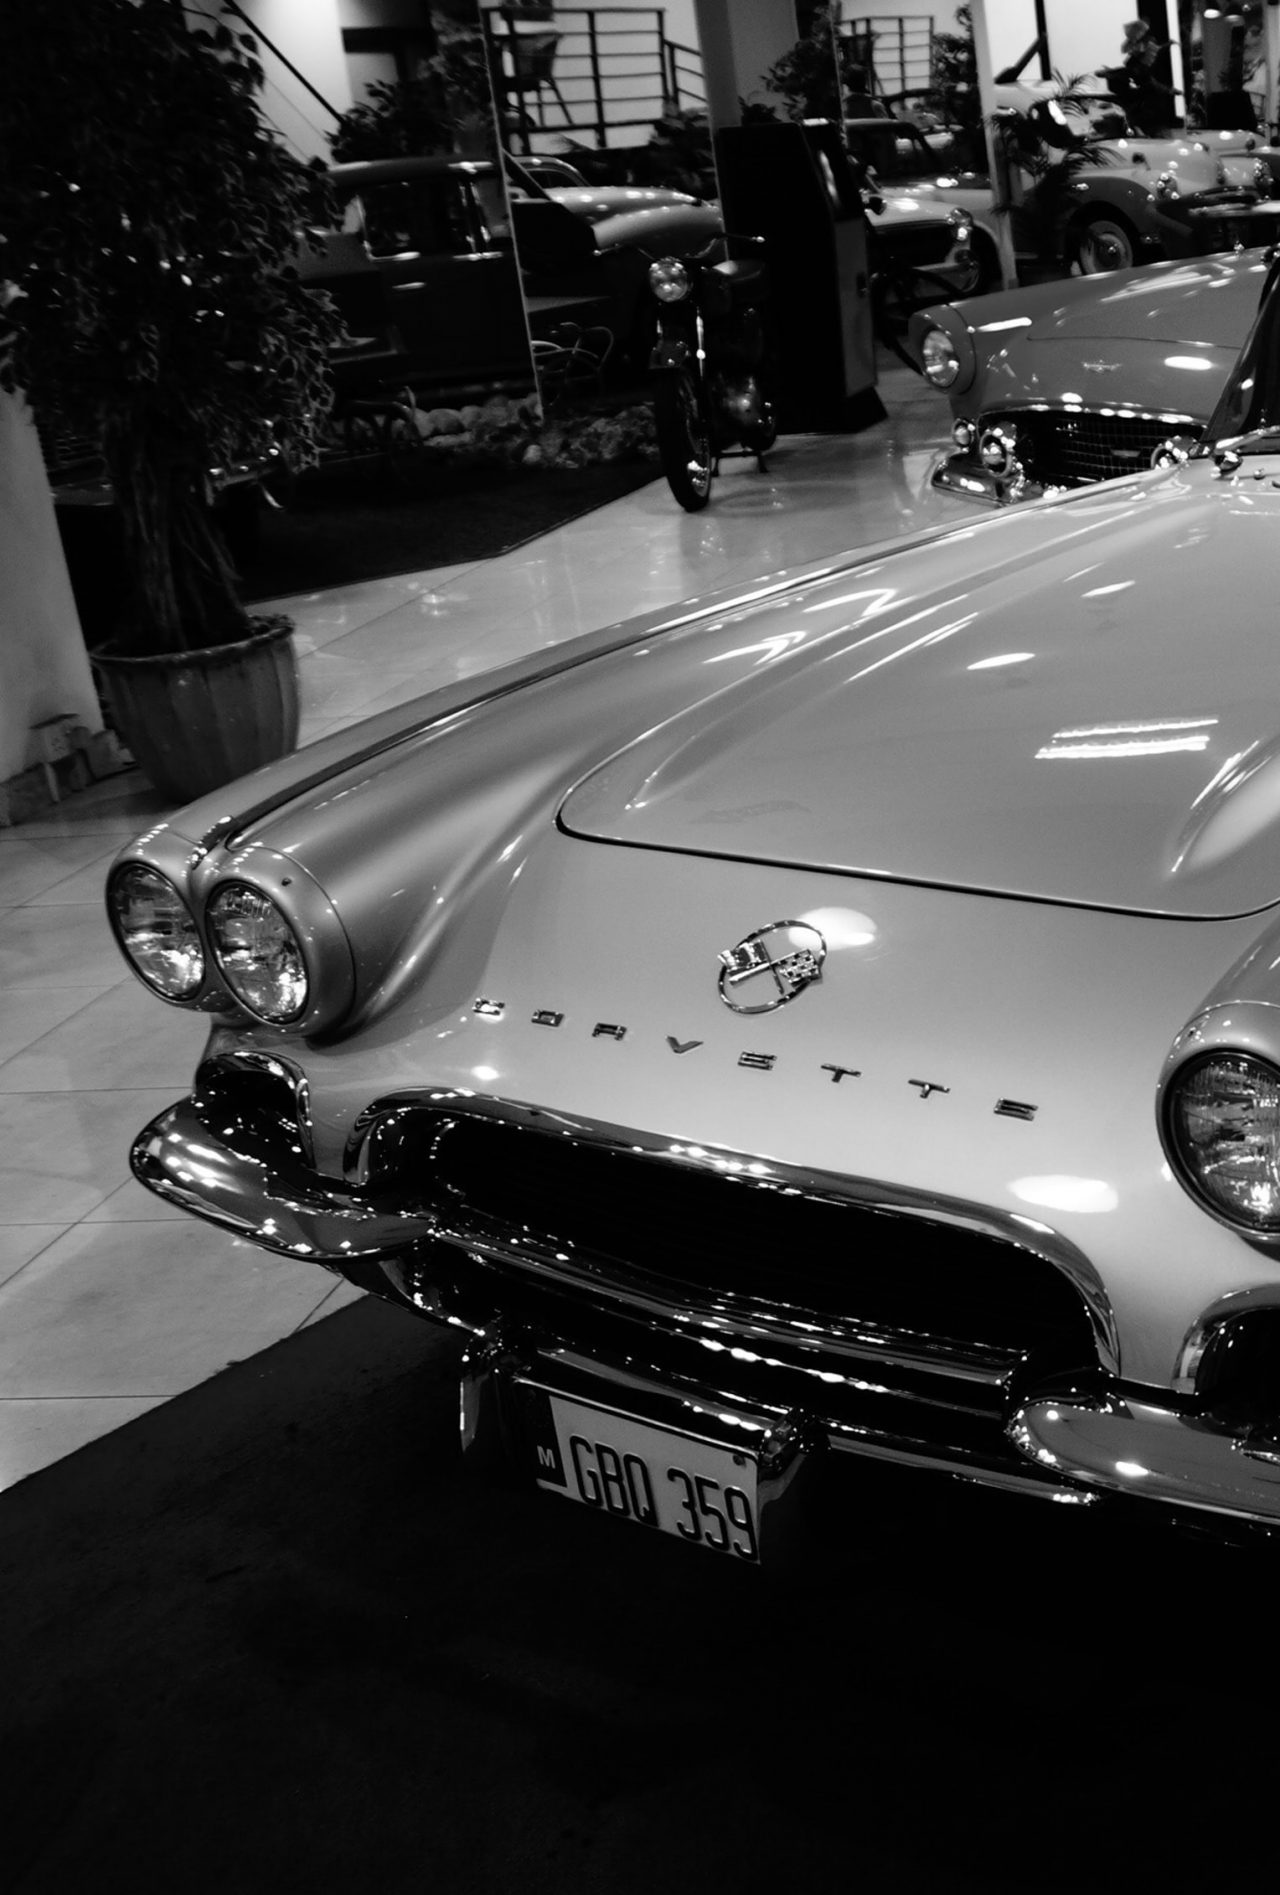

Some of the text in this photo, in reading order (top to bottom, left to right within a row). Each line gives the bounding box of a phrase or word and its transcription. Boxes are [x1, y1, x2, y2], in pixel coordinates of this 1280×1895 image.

[472, 996, 1039, 1121] CORVETTE
[536, 1444, 556, 1470] M
[569, 1434, 759, 1561] GBQ 359
